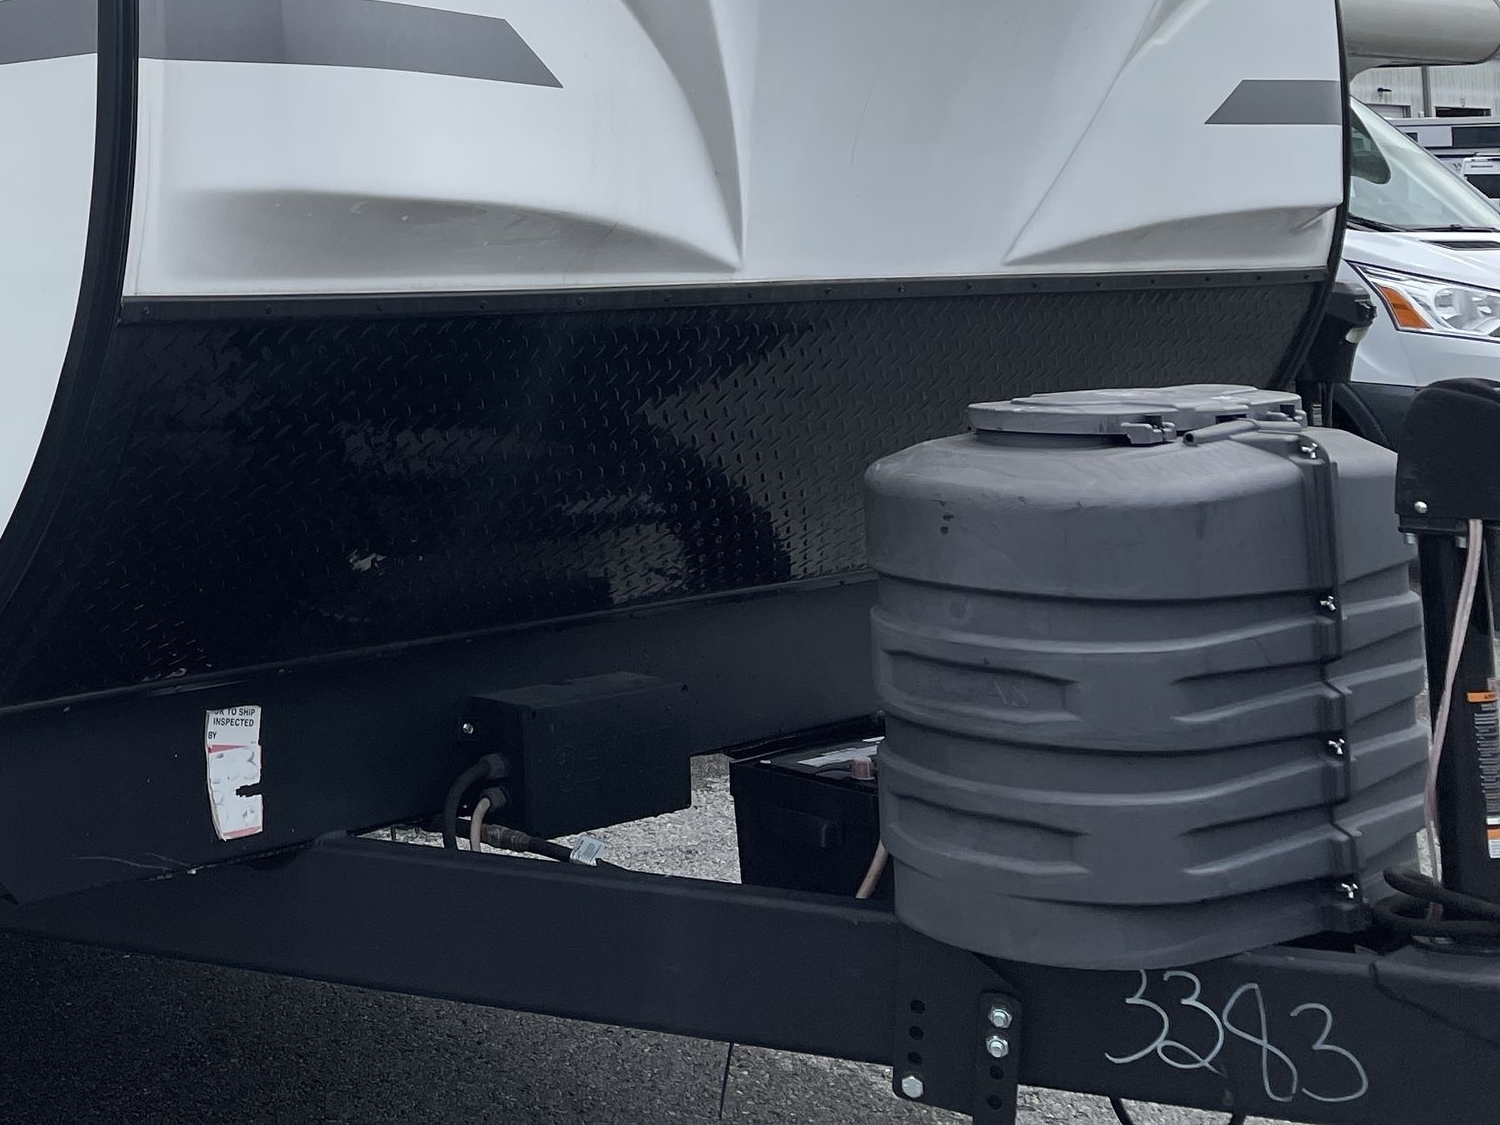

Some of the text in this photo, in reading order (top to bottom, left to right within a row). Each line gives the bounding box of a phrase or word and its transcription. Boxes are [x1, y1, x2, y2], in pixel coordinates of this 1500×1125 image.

[228, 707, 237, 716] TO
[239, 708, 256, 716] SHIP
[213, 717, 254, 726] INSPECTED
[207, 731, 217, 740] BY
